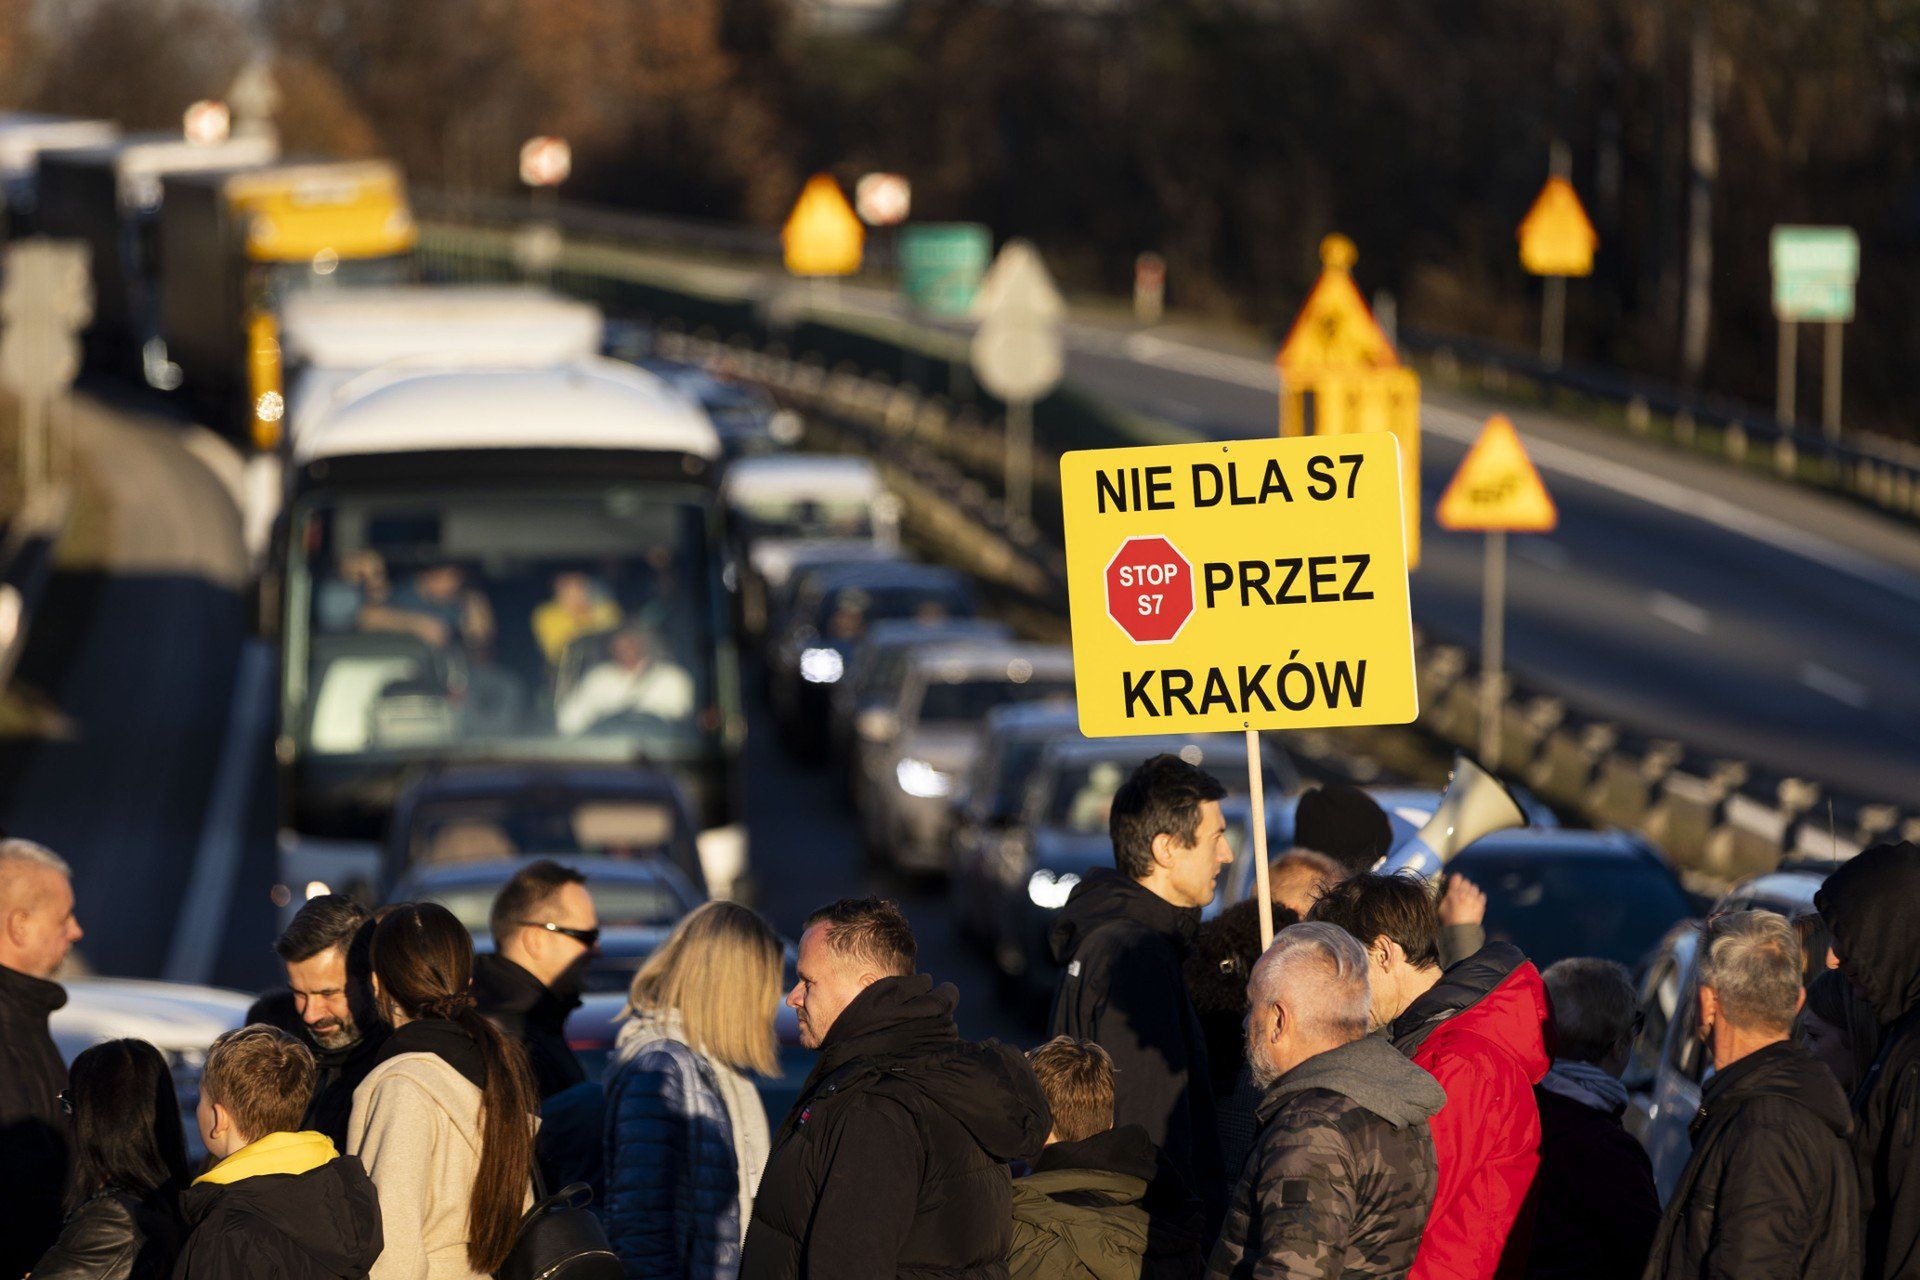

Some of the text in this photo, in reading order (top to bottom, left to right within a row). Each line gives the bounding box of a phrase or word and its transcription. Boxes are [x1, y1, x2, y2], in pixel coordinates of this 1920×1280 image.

[1096, 454, 1364, 514] NIE DLA S7
[1119, 564, 1178, 587] STOP
[1204, 554, 1375, 609] PRZEZ
[1137, 594, 1164, 616] S7
[1122, 649, 1367, 718] KRAKÓW
